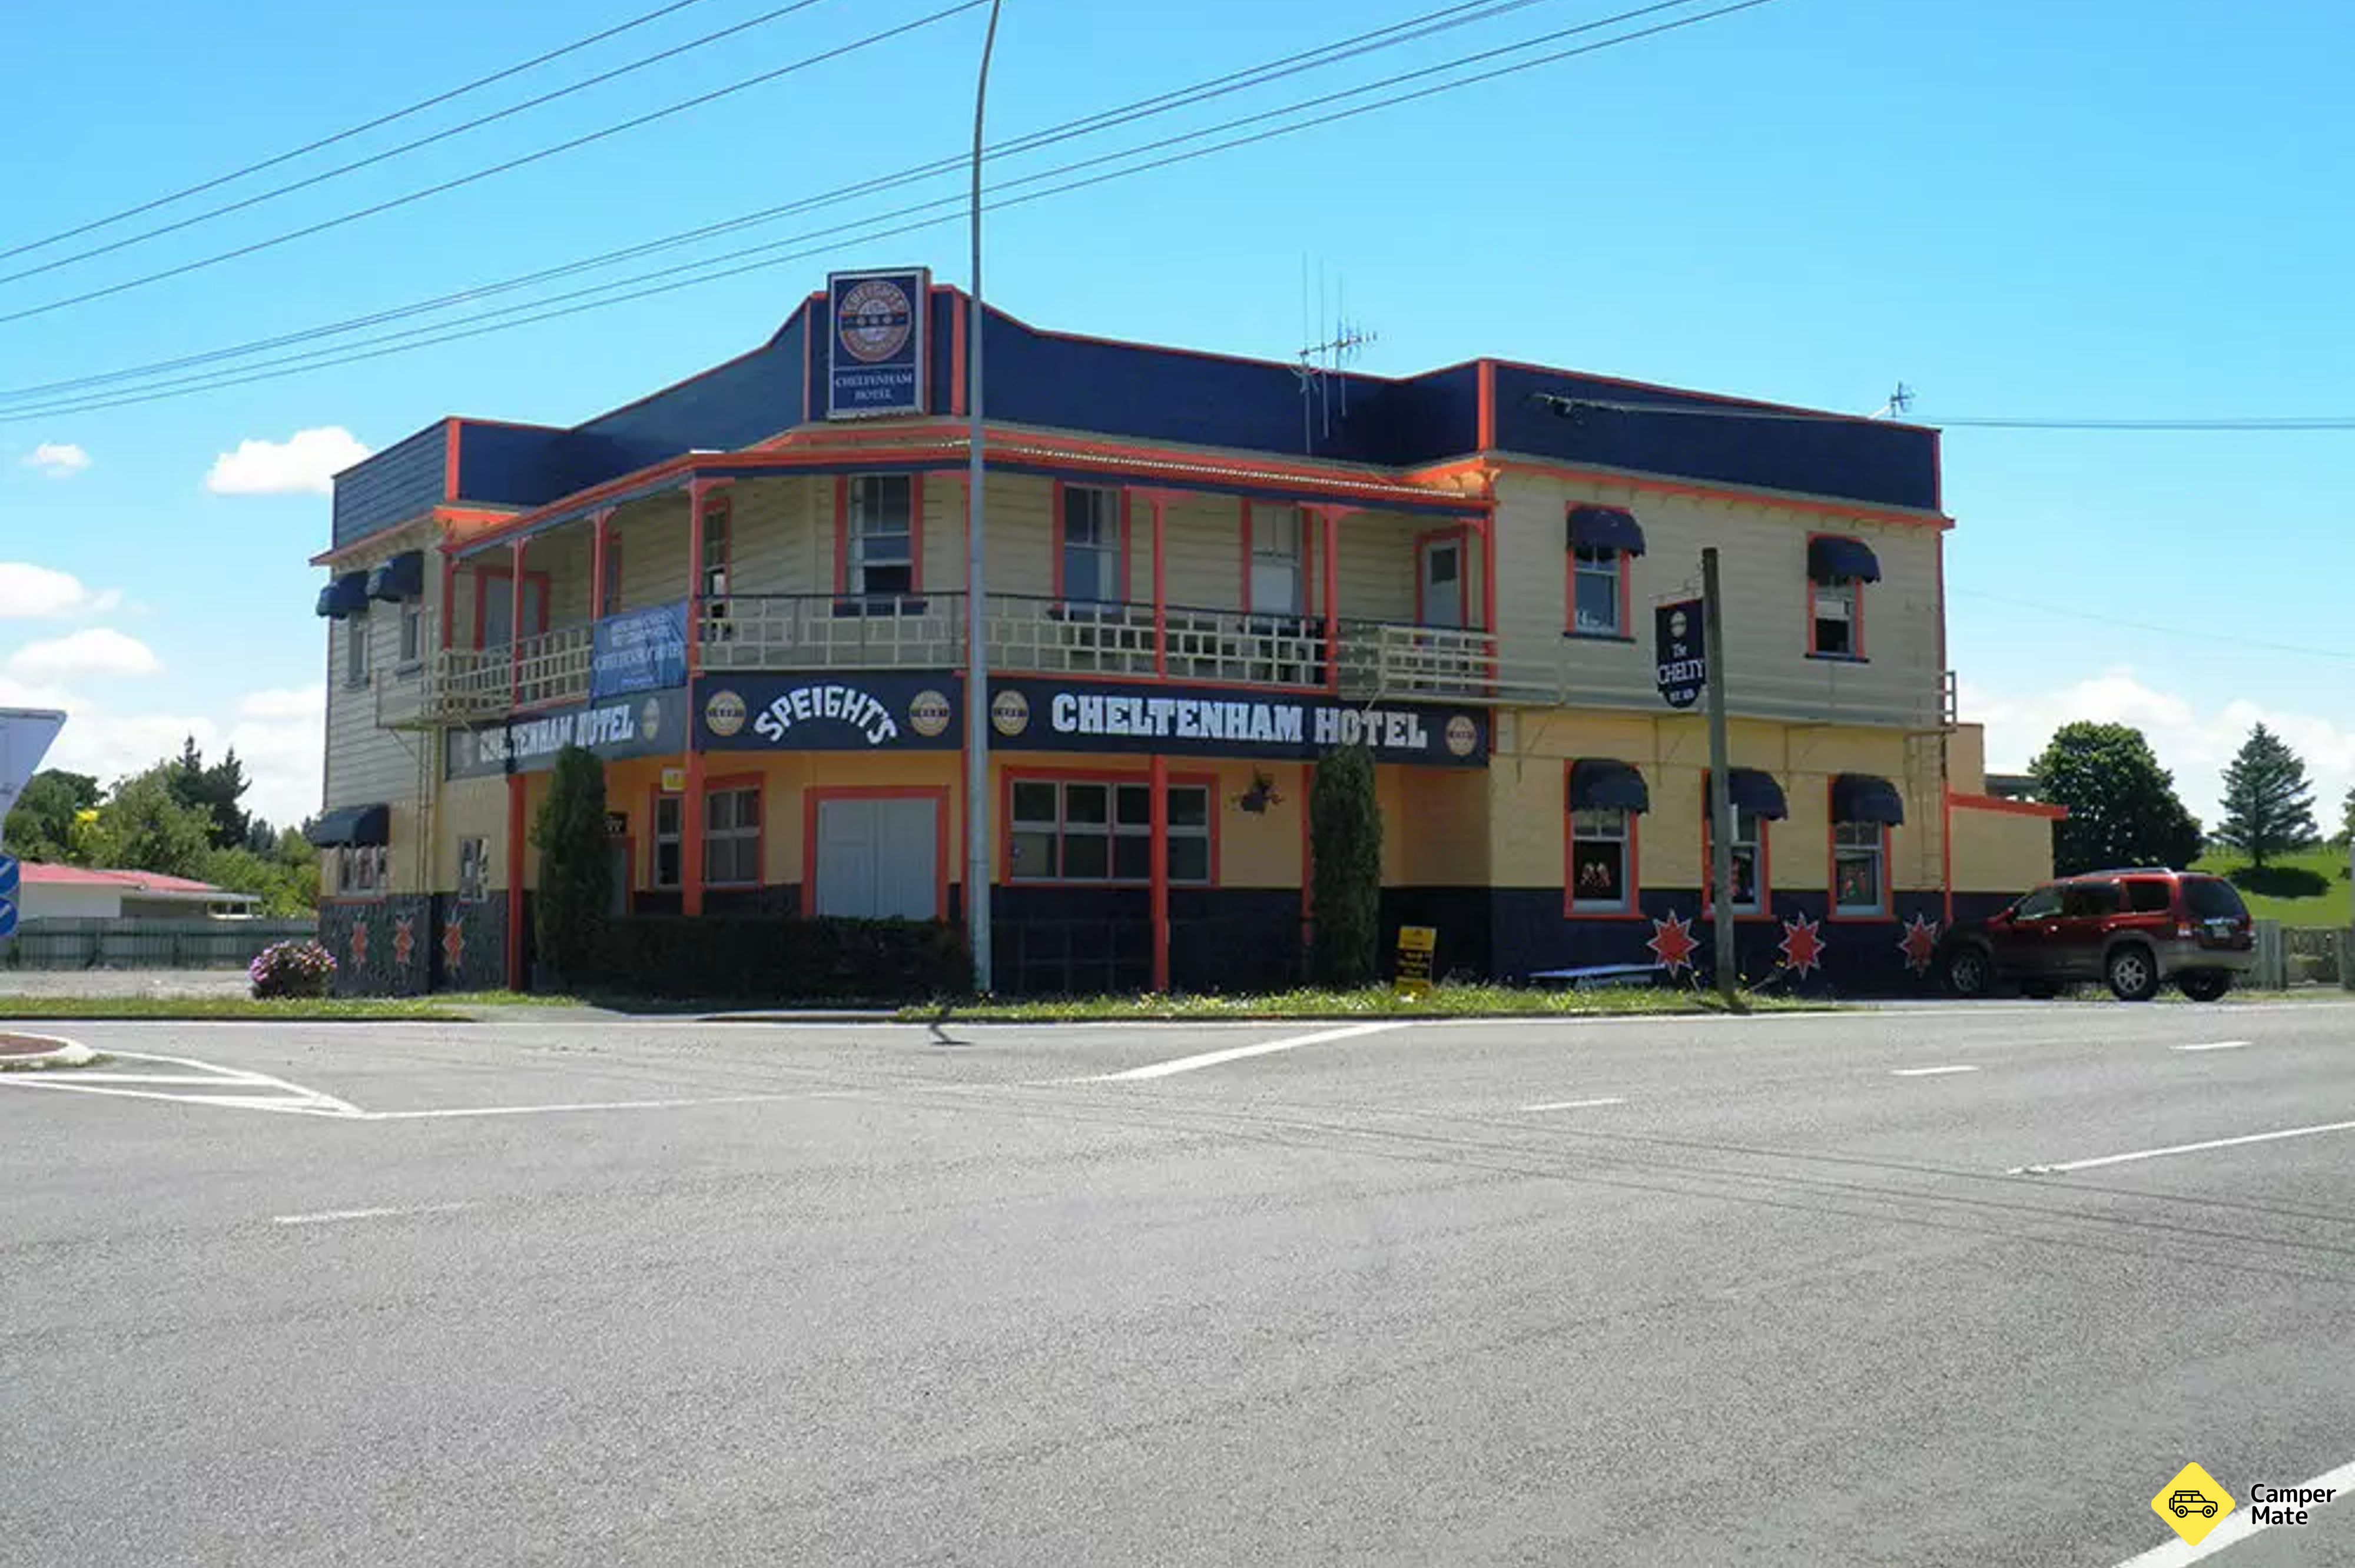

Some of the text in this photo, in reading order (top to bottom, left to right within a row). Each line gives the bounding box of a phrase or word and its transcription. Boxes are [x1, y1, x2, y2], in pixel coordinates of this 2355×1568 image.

[835, 373, 913, 388] CHELTENHAM
[1657, 659, 1704, 685] CHELTY
[575, 705, 634, 748] HOTEL
[754, 686, 898, 745] SPEIGHT'S
[1052, 693, 1303, 742] CHELTENHAM
[1314, 707, 1428, 748] HOTEL
